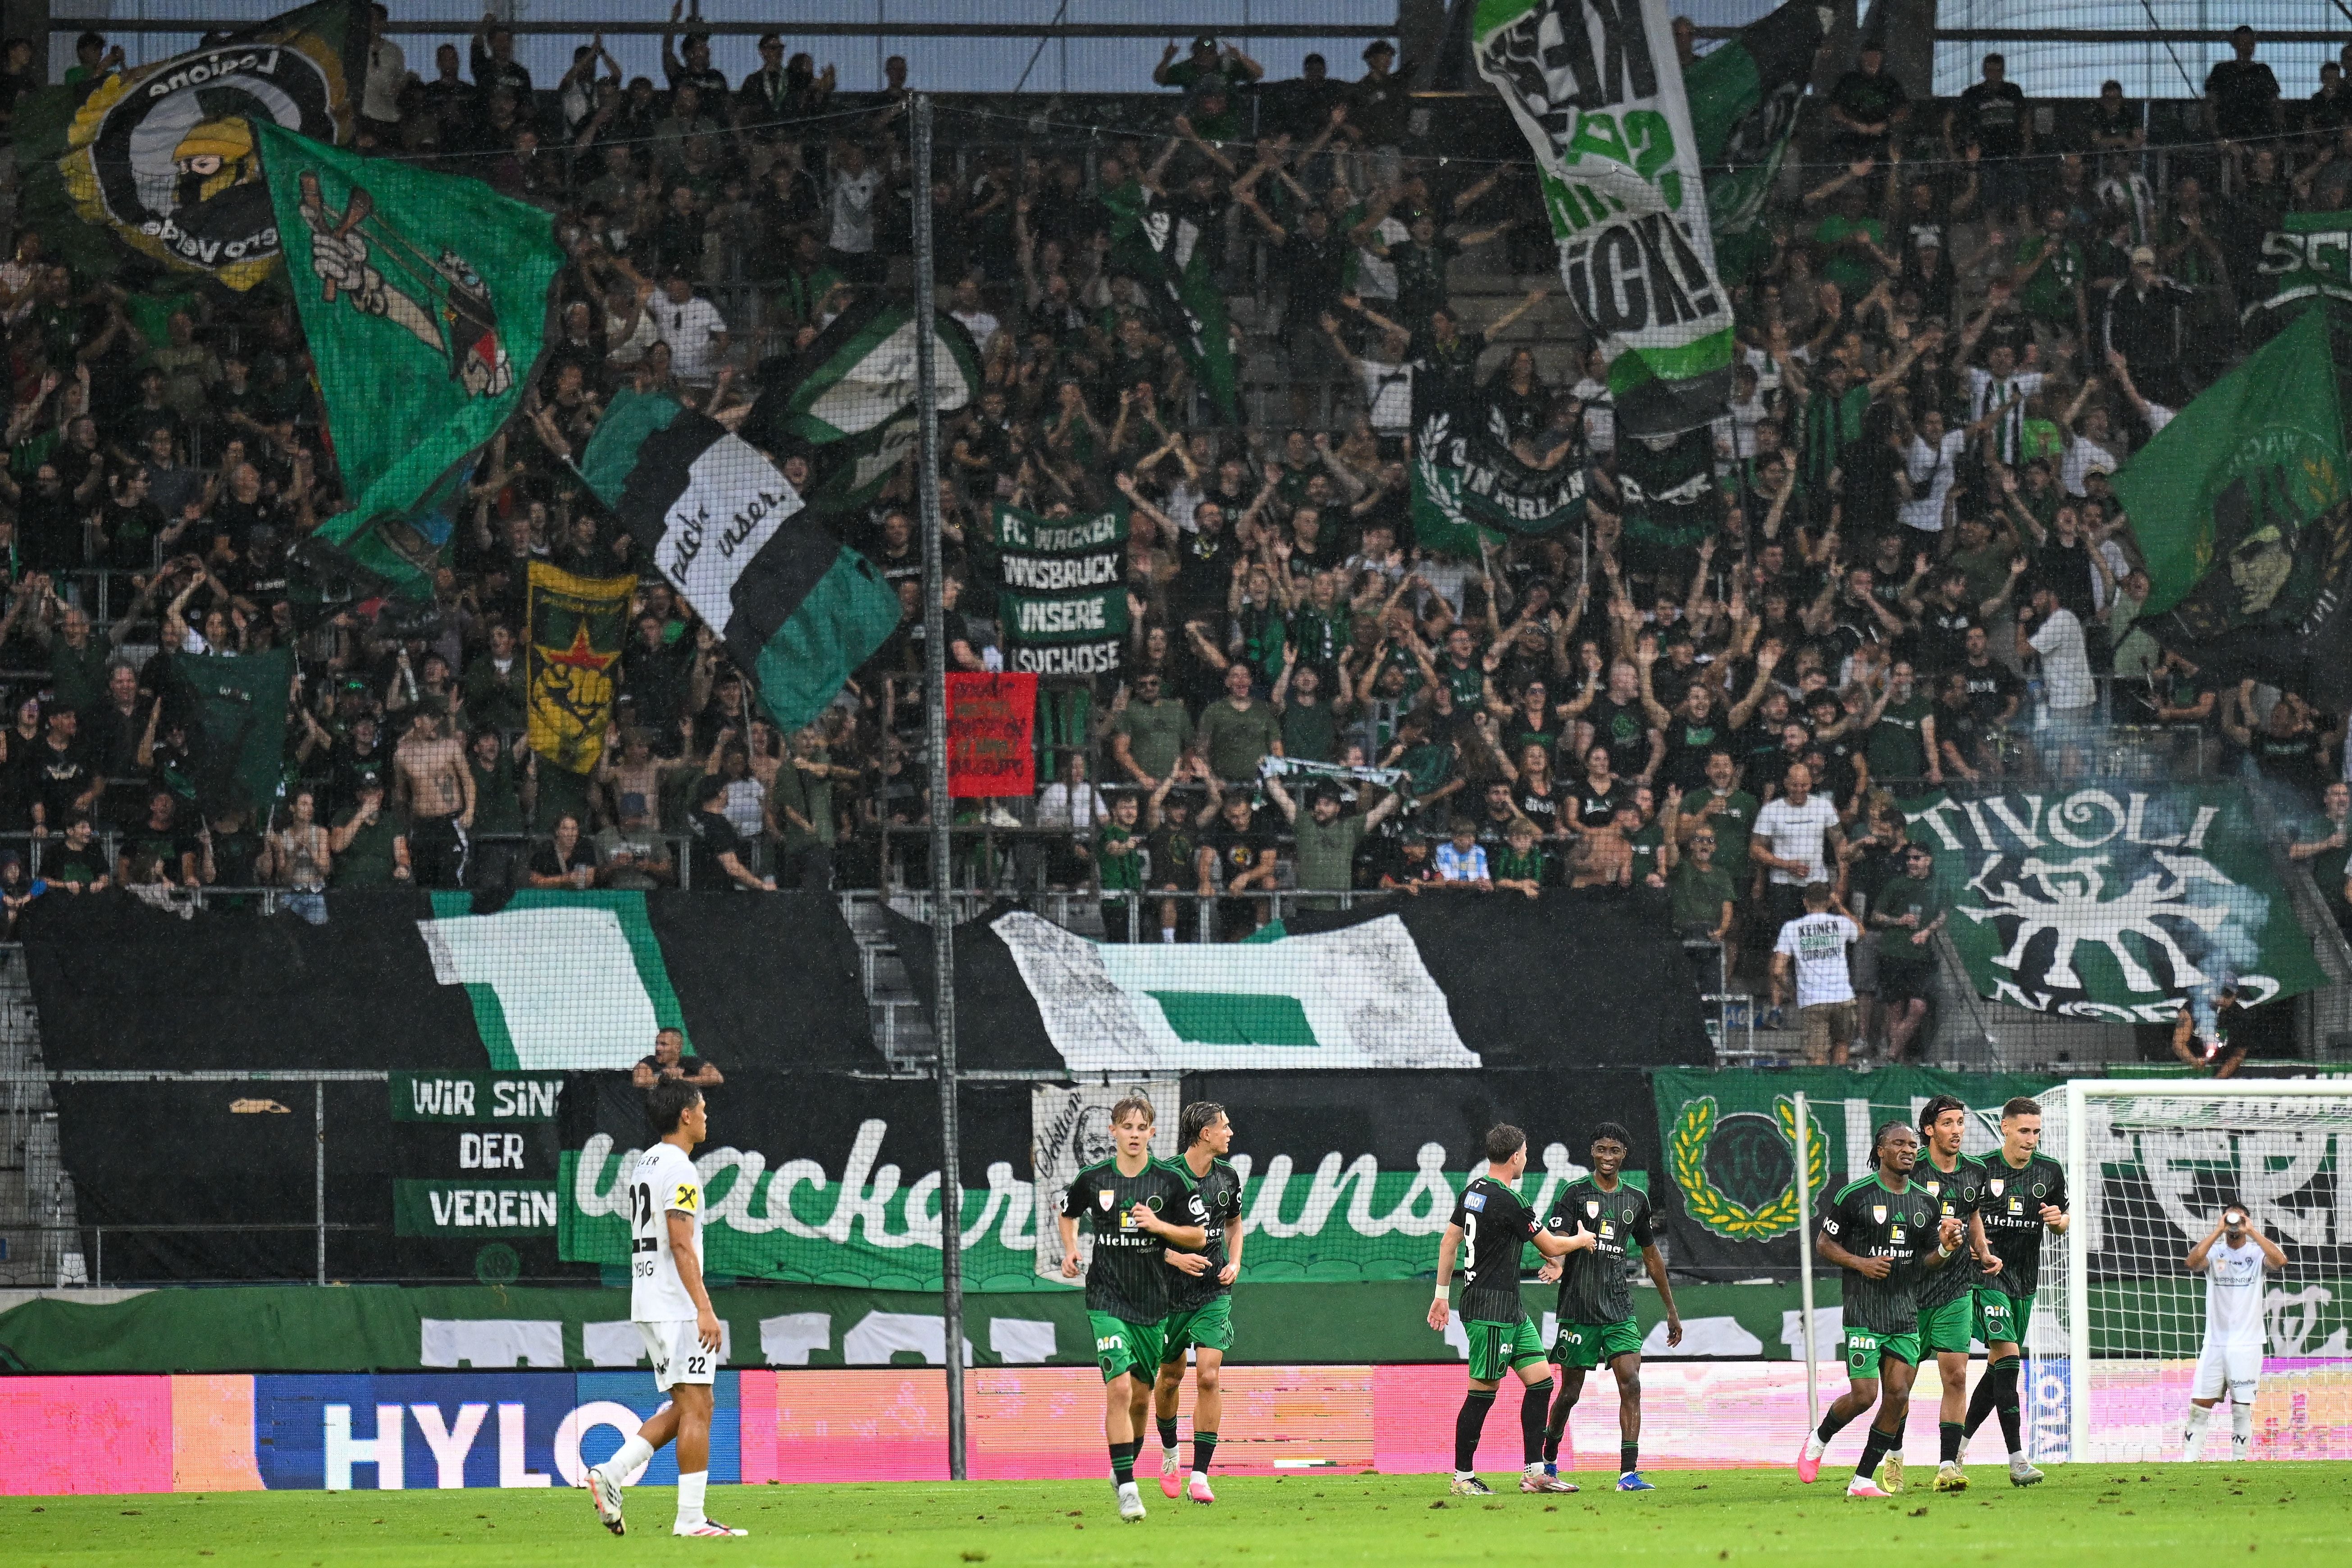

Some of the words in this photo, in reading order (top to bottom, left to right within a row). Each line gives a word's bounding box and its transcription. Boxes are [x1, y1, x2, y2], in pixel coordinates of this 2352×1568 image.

[1002, 513, 1028, 545] FC
[1034, 512, 1117, 551] WACKER
[1015, 596, 1106, 633] UNSERE
[1905, 788, 2220, 851] TIVOLI
[459, 1132, 524, 1169] DER
[1984, 1214, 2037, 1228] Aichner
[1097, 1233, 1157, 1246] Aichner
[1868, 1246, 1914, 1258] Aichner
[1984, 1305, 2011, 1317] Ain
[1097, 1335, 1122, 1351] Ain
[1559, 1329, 1582, 1345] Ain
[1849, 1336, 1876, 1350] Ain
[688, 1356, 706, 1374] 22
[323, 1401, 650, 1490] HYLO
